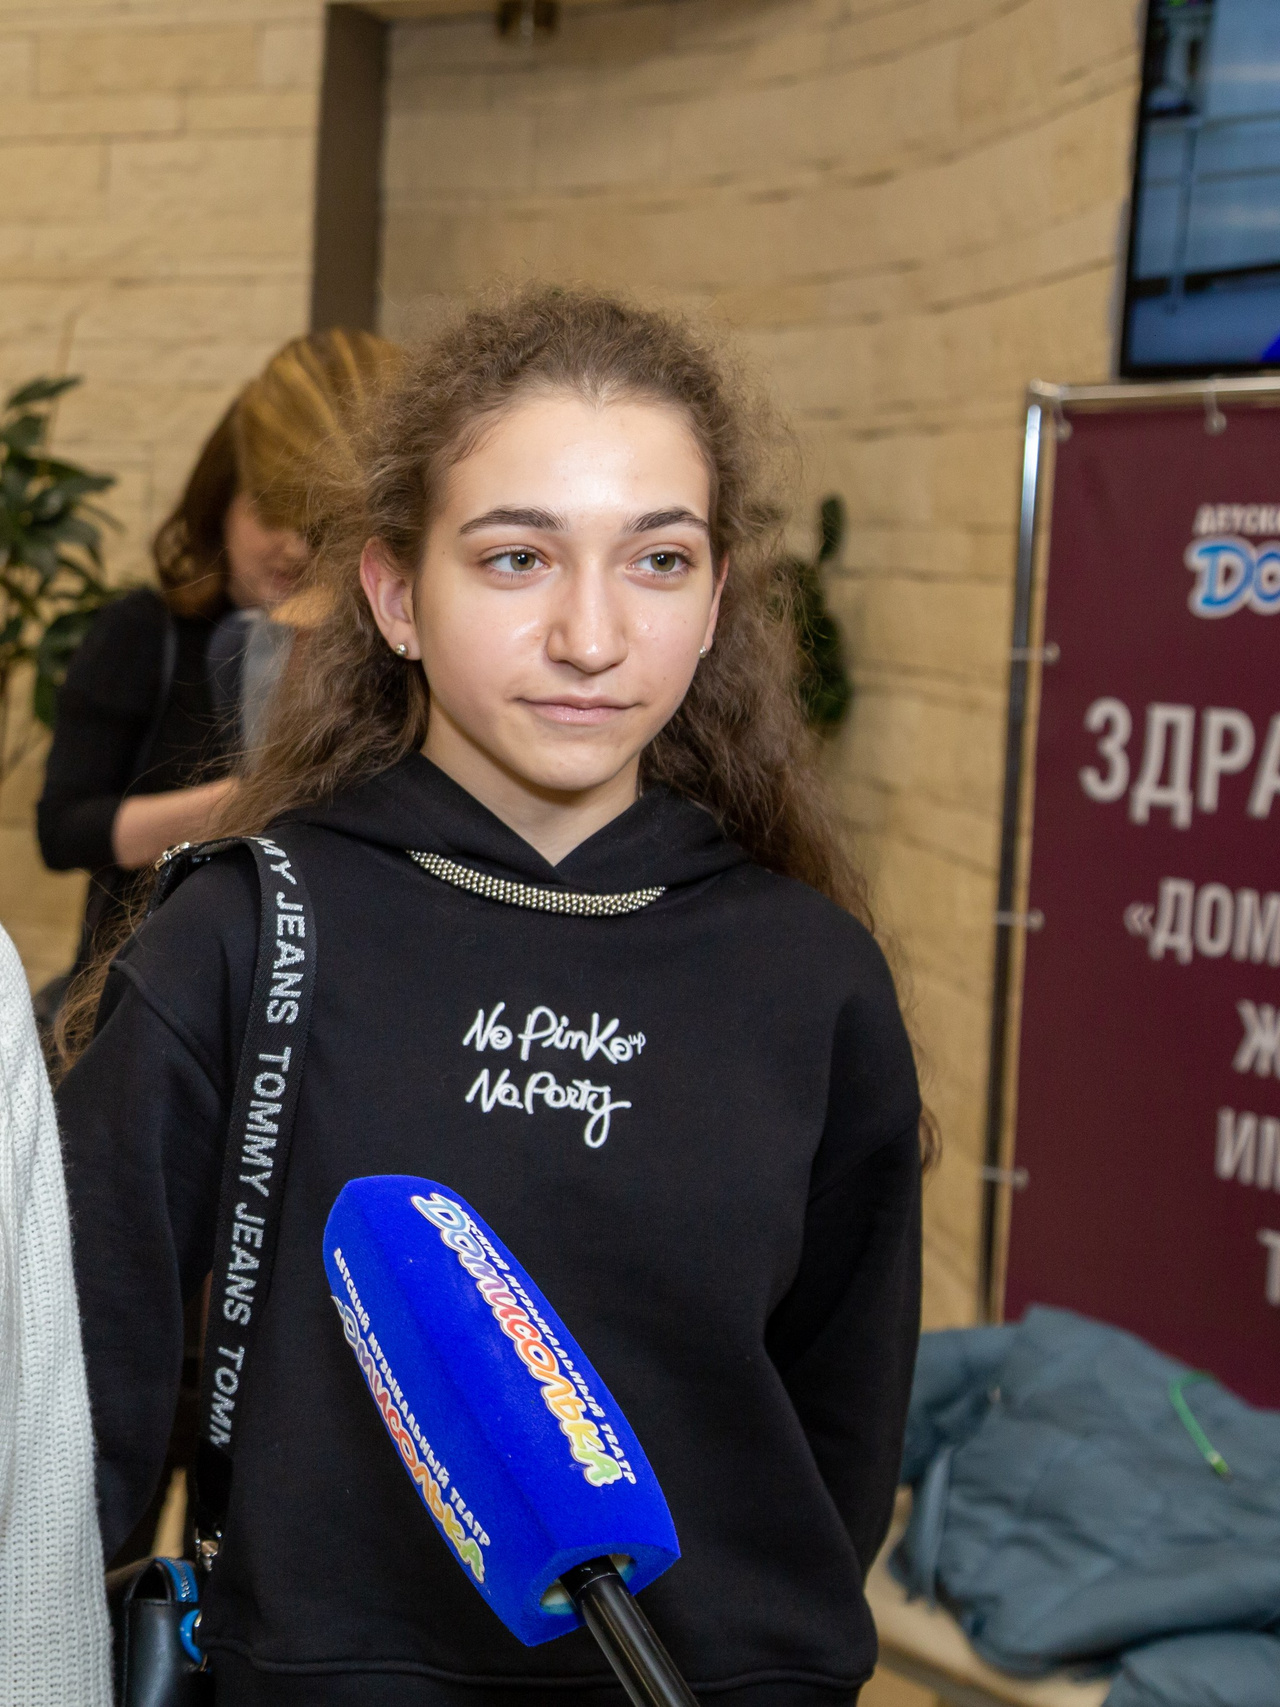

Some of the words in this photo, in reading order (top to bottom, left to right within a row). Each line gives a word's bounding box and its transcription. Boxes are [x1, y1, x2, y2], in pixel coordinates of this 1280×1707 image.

[1193, 503, 1280, 536] ДЕТСК
[266, 891, 306, 1025] JEANS
[462, 1001, 513, 1051] No
[239, 1047, 292, 1198] TOMMY
[223, 1202, 266, 1326] JEANS
[330, 1295, 485, 1584] ОМИСОЛЬКА
[333, 1247, 370, 1333] ДЕТСКИЙ
[368, 1332, 450, 1489] МУЗЫКАЛЬНЫЙ
[449, 1487, 491, 1547] ТЕАТР
[503, 1273, 606, 1419] МУЗЫКАЛЬНЫЙ
[600, 1423, 637, 1485] ТЕАТР
